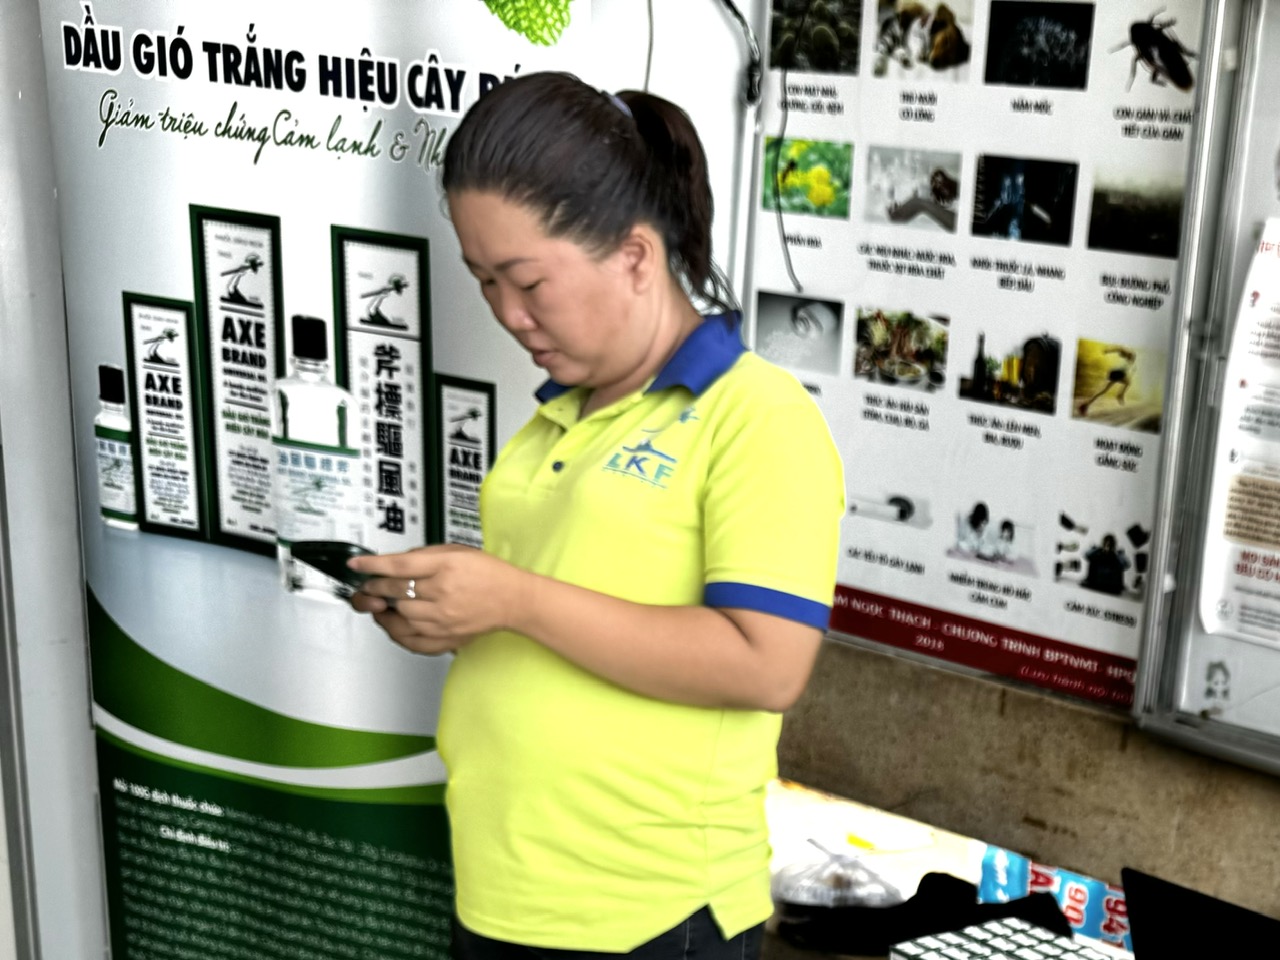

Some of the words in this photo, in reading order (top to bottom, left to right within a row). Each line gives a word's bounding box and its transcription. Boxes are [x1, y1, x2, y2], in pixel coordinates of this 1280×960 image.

[63, 4, 122, 72] DẦU
[132, 25, 193, 80] GIÓ
[202, 23, 306, 93] TRẮNG
[318, 47, 398, 112] HIỆU
[407, 53, 466, 113] CÂY
[99, 89, 156, 147] Giảm
[158, 107, 209, 140] triệu
[215, 101, 272, 164] chứng
[272, 109, 320, 150] Cảm
[325, 115, 383, 160] lạnh
[389, 132, 409, 162] &
[222, 316, 266, 349] AXE
[222, 347, 266, 369] BRAND
[145, 372, 182, 396] AXE
[145, 394, 183, 411] BRAND
[450, 447, 482, 471] AXE
